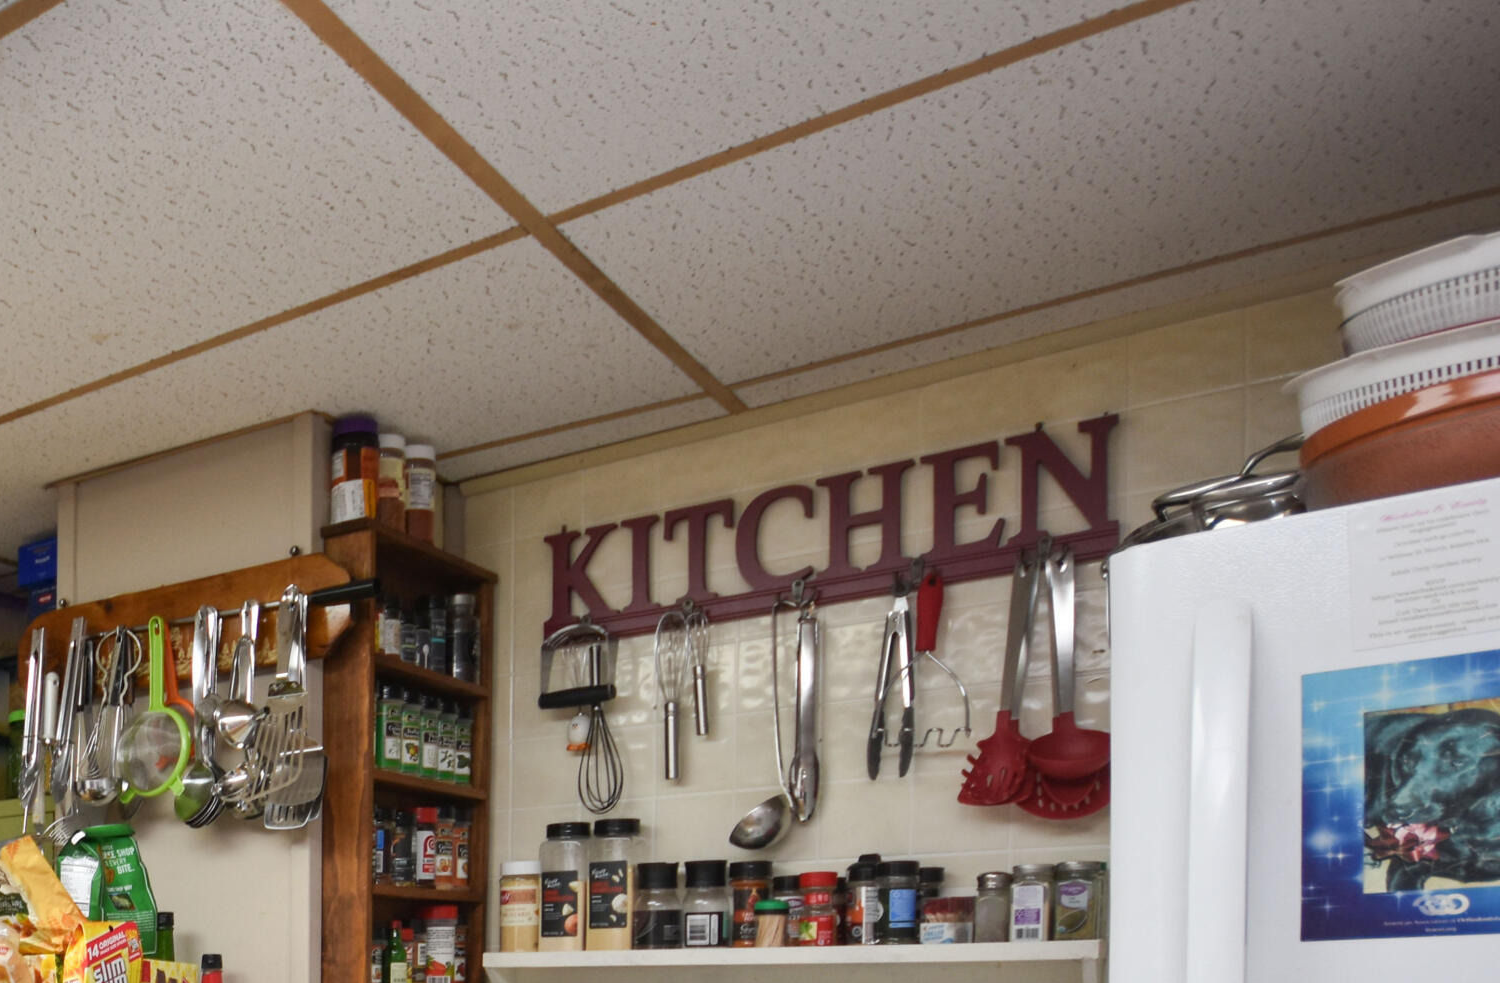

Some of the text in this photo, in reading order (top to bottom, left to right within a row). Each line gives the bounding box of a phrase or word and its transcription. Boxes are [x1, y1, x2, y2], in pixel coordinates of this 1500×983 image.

[544, 413, 1119, 624] KITCHEN
[87, 942, 101, 961] 14
[99, 930, 126, 950] ORIGINAL
